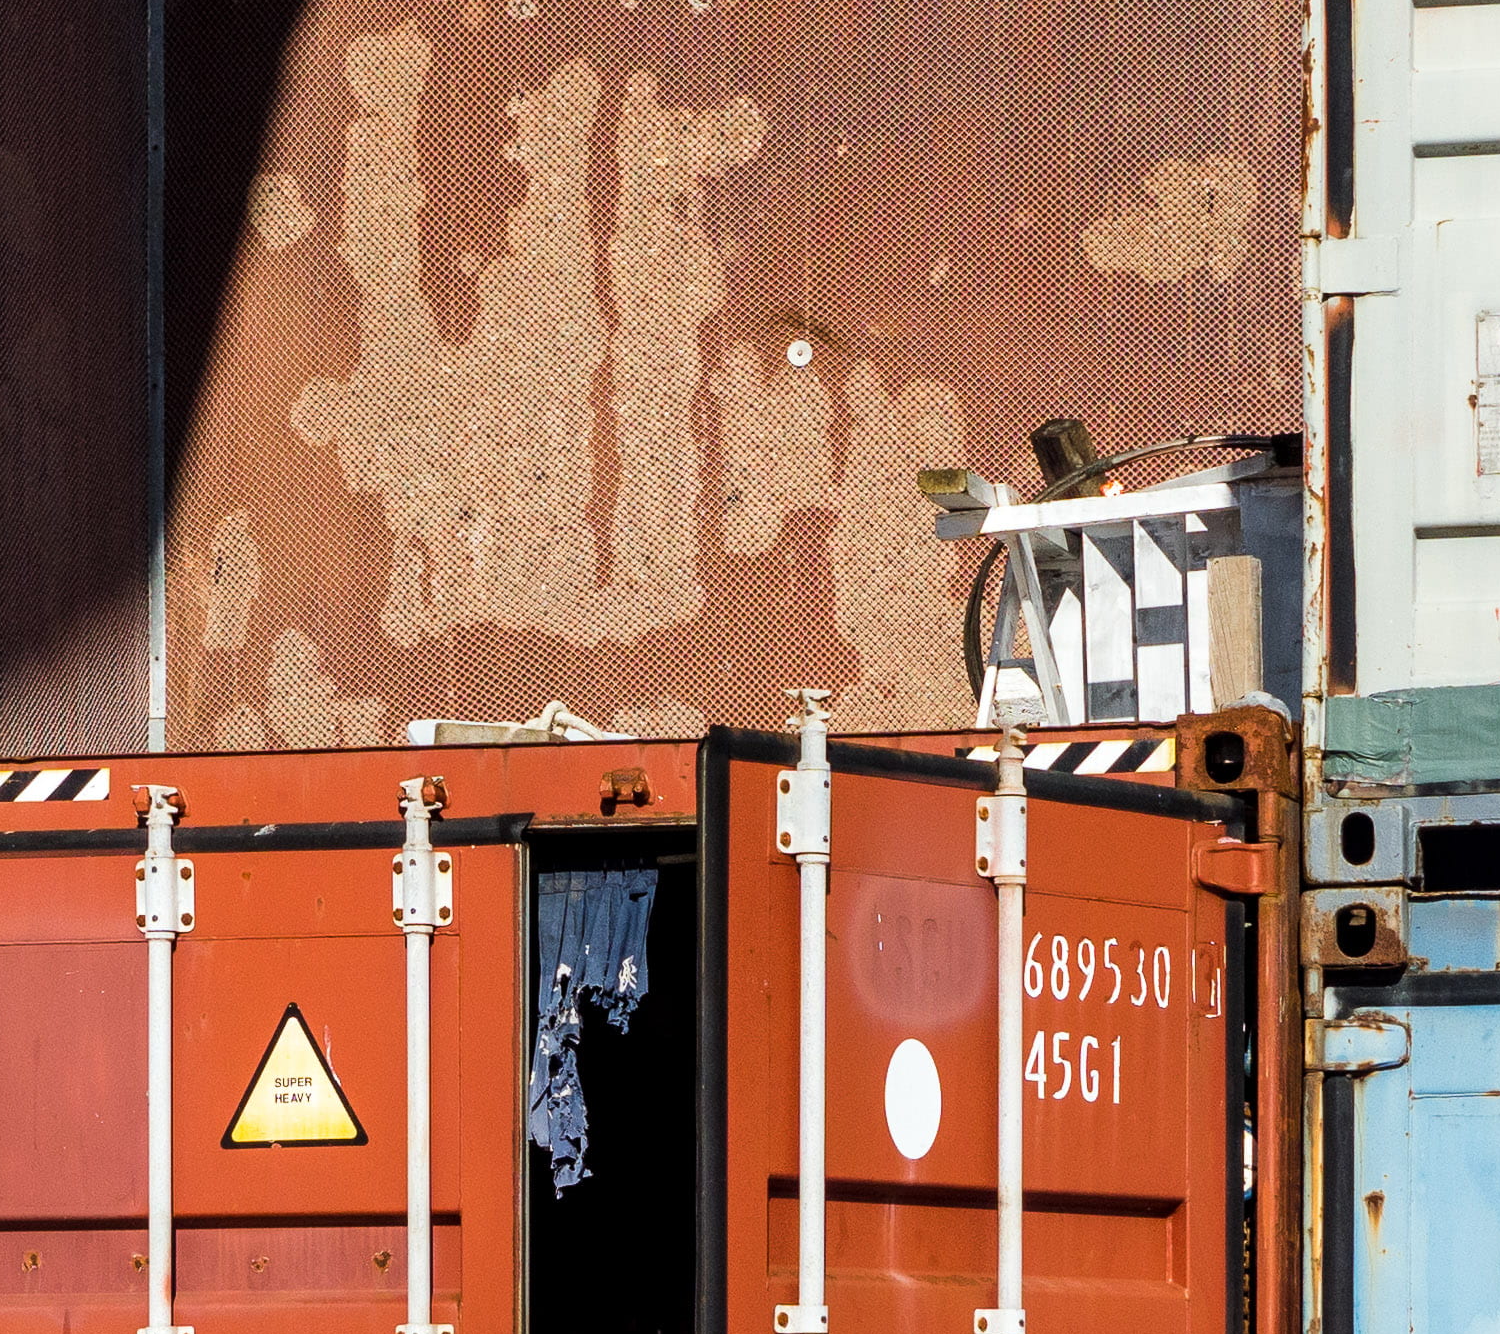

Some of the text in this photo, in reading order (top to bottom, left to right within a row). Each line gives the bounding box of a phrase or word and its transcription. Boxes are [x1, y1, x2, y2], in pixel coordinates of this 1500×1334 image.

[1023, 932, 1171, 1009] 689530
[274, 1076, 313, 1088] SUPER
[1024, 1030, 1121, 1104] 45G1
[274, 1092, 312, 1104] HEAVY
